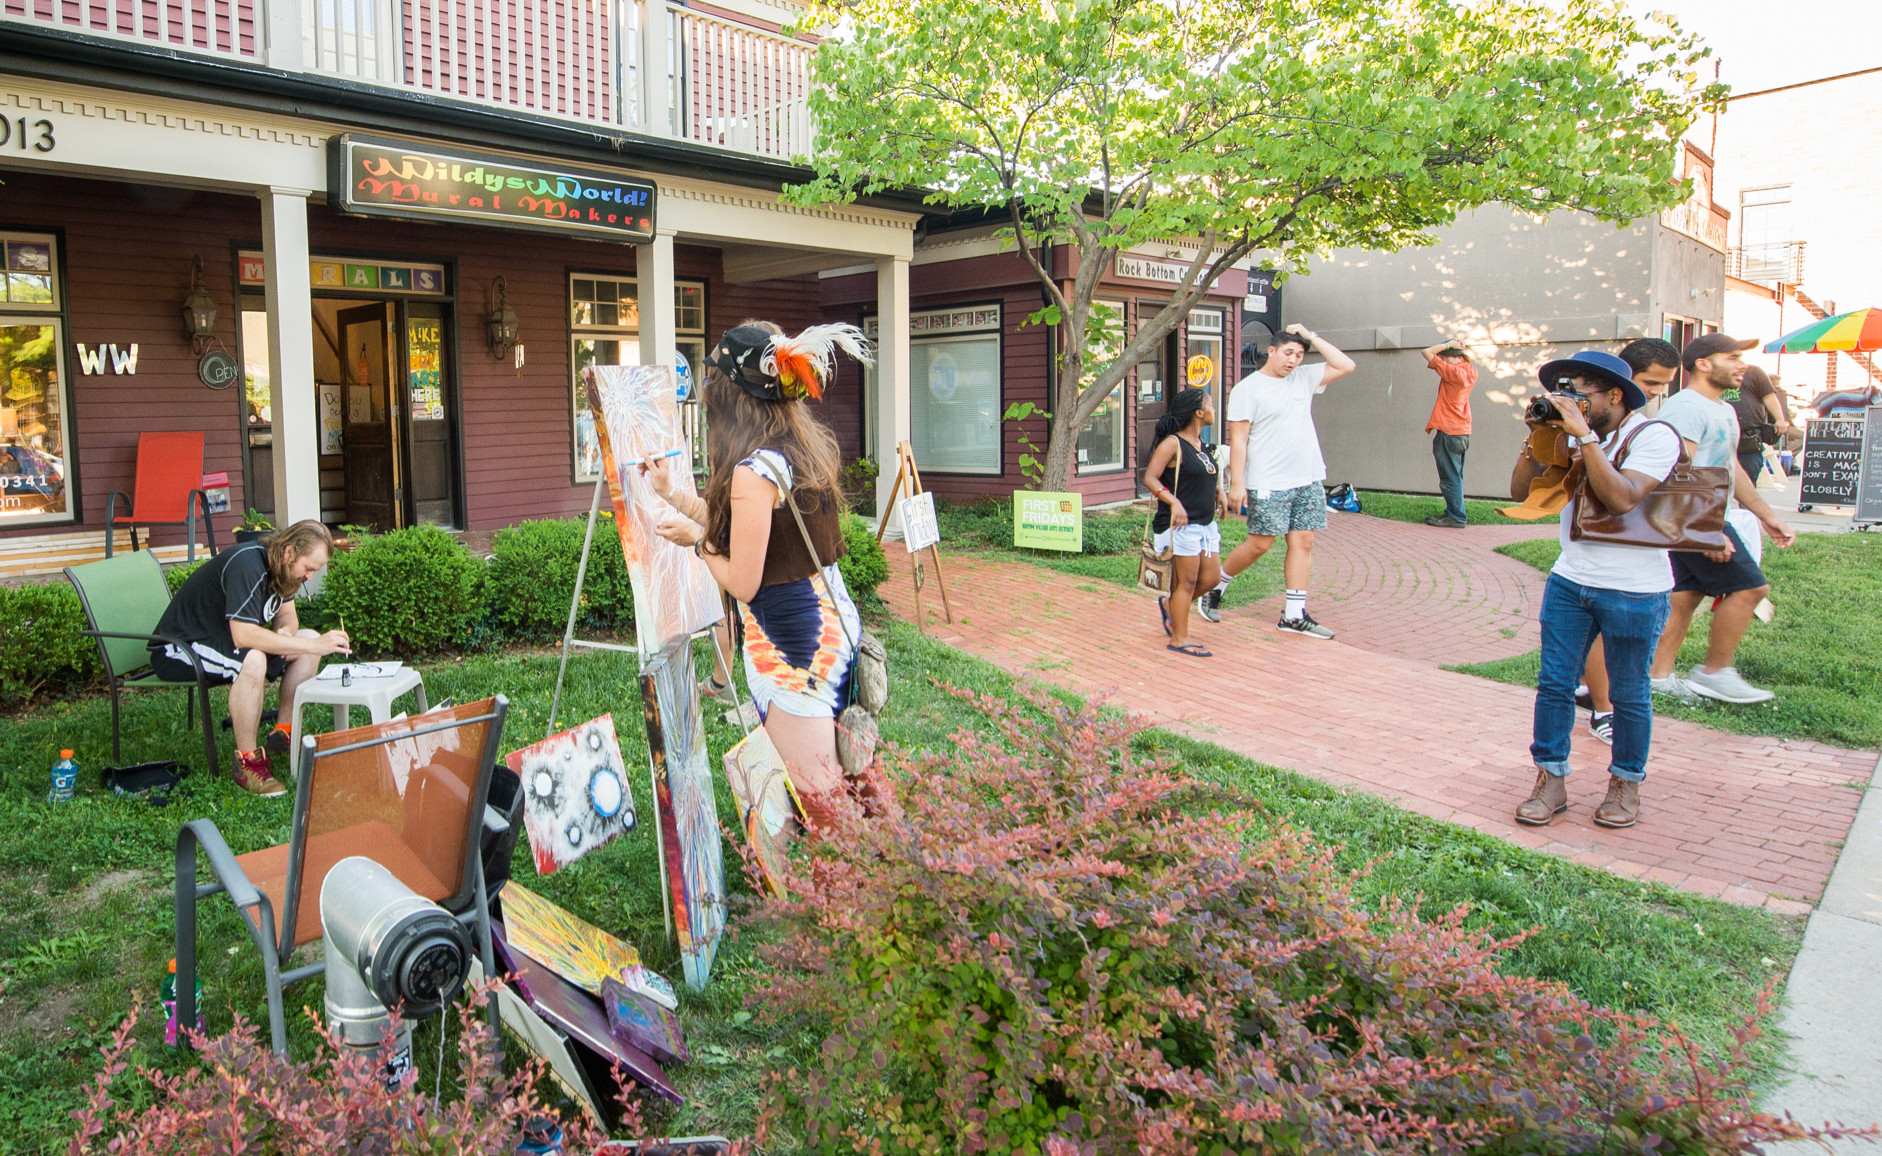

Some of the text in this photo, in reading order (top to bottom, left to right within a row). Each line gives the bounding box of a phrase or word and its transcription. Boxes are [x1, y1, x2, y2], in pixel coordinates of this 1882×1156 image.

[358, 177, 650, 228] Mural Makers
[243, 263, 434, 290] MRALS
[1119, 259, 1141, 277] Rock
[1145, 262, 1176, 281] Bottom
[203, 356, 238, 385] OPEN
[411, 371, 440, 388] ART
[411, 388, 440, 403] HERE
[1808, 460, 1860, 471] IS MAG
[1802, 484, 1853, 496] CLOSELY
[1022, 499, 1058, 513] FIRST
[1022, 511, 1076, 526] FRIDAYS
